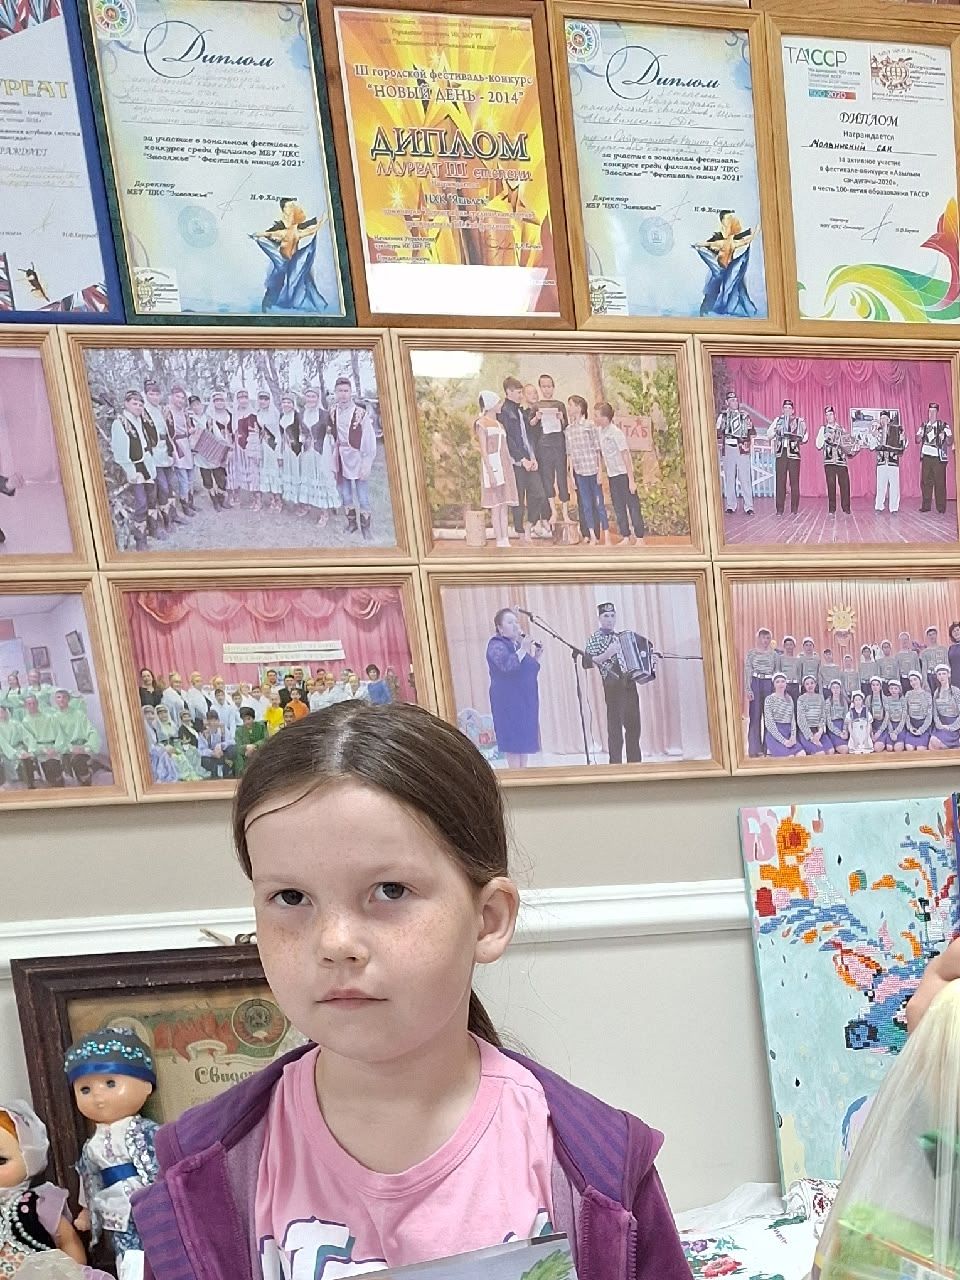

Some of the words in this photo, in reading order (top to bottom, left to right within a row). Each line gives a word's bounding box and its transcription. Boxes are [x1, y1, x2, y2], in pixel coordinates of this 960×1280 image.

[144, 20, 275, 78] Диплом
[784, 46, 848, 68] ТАССР
[372, 66, 427, 80] городской
[430, 69, 533, 87] фестиваль-конкурс
[606, 45, 721, 100] Диплом
[0, 79, 68, 99] РЕАТ
[436, 87, 476, 103] ДЕНЬ
[839, 112, 899, 127] ДИПЛОМ
[370, 125, 531, 161] ДИПЛОМ
[843, 130, 895, 141] Награждается
[376, 160, 442, 178] ЛАУРЕАТ
[909, 190, 929, 198] ТАССР
[195, 1066, 256, 1085] Свиде
